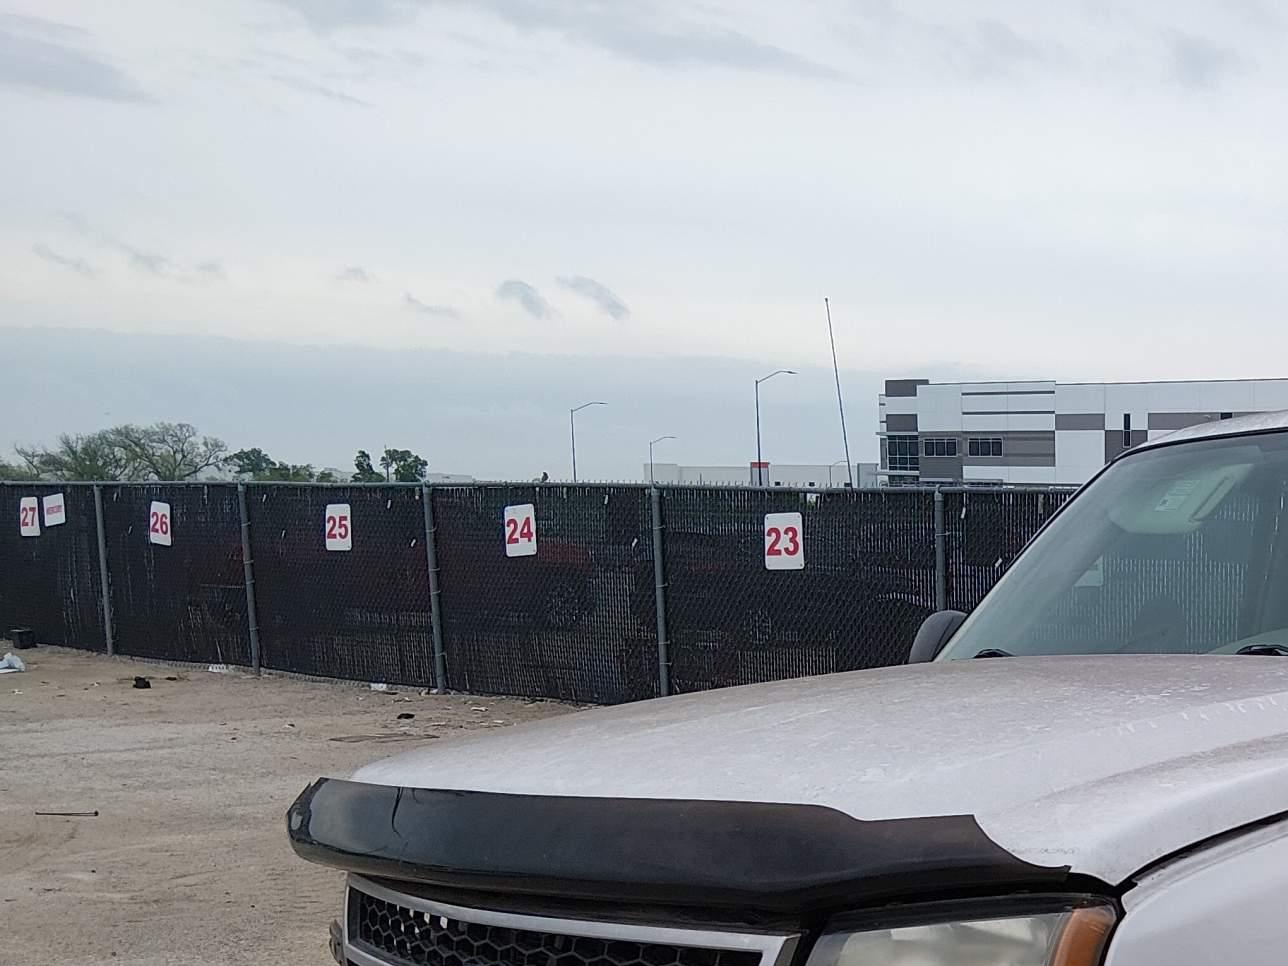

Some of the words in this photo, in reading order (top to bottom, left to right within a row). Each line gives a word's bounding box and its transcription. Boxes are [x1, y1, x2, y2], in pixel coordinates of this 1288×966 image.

[20, 506, 37, 528] 27
[150, 511, 169, 535] 26
[326, 515, 349, 540] 25
[505, 516, 533, 545] 24
[766, 526, 800, 557] 23
